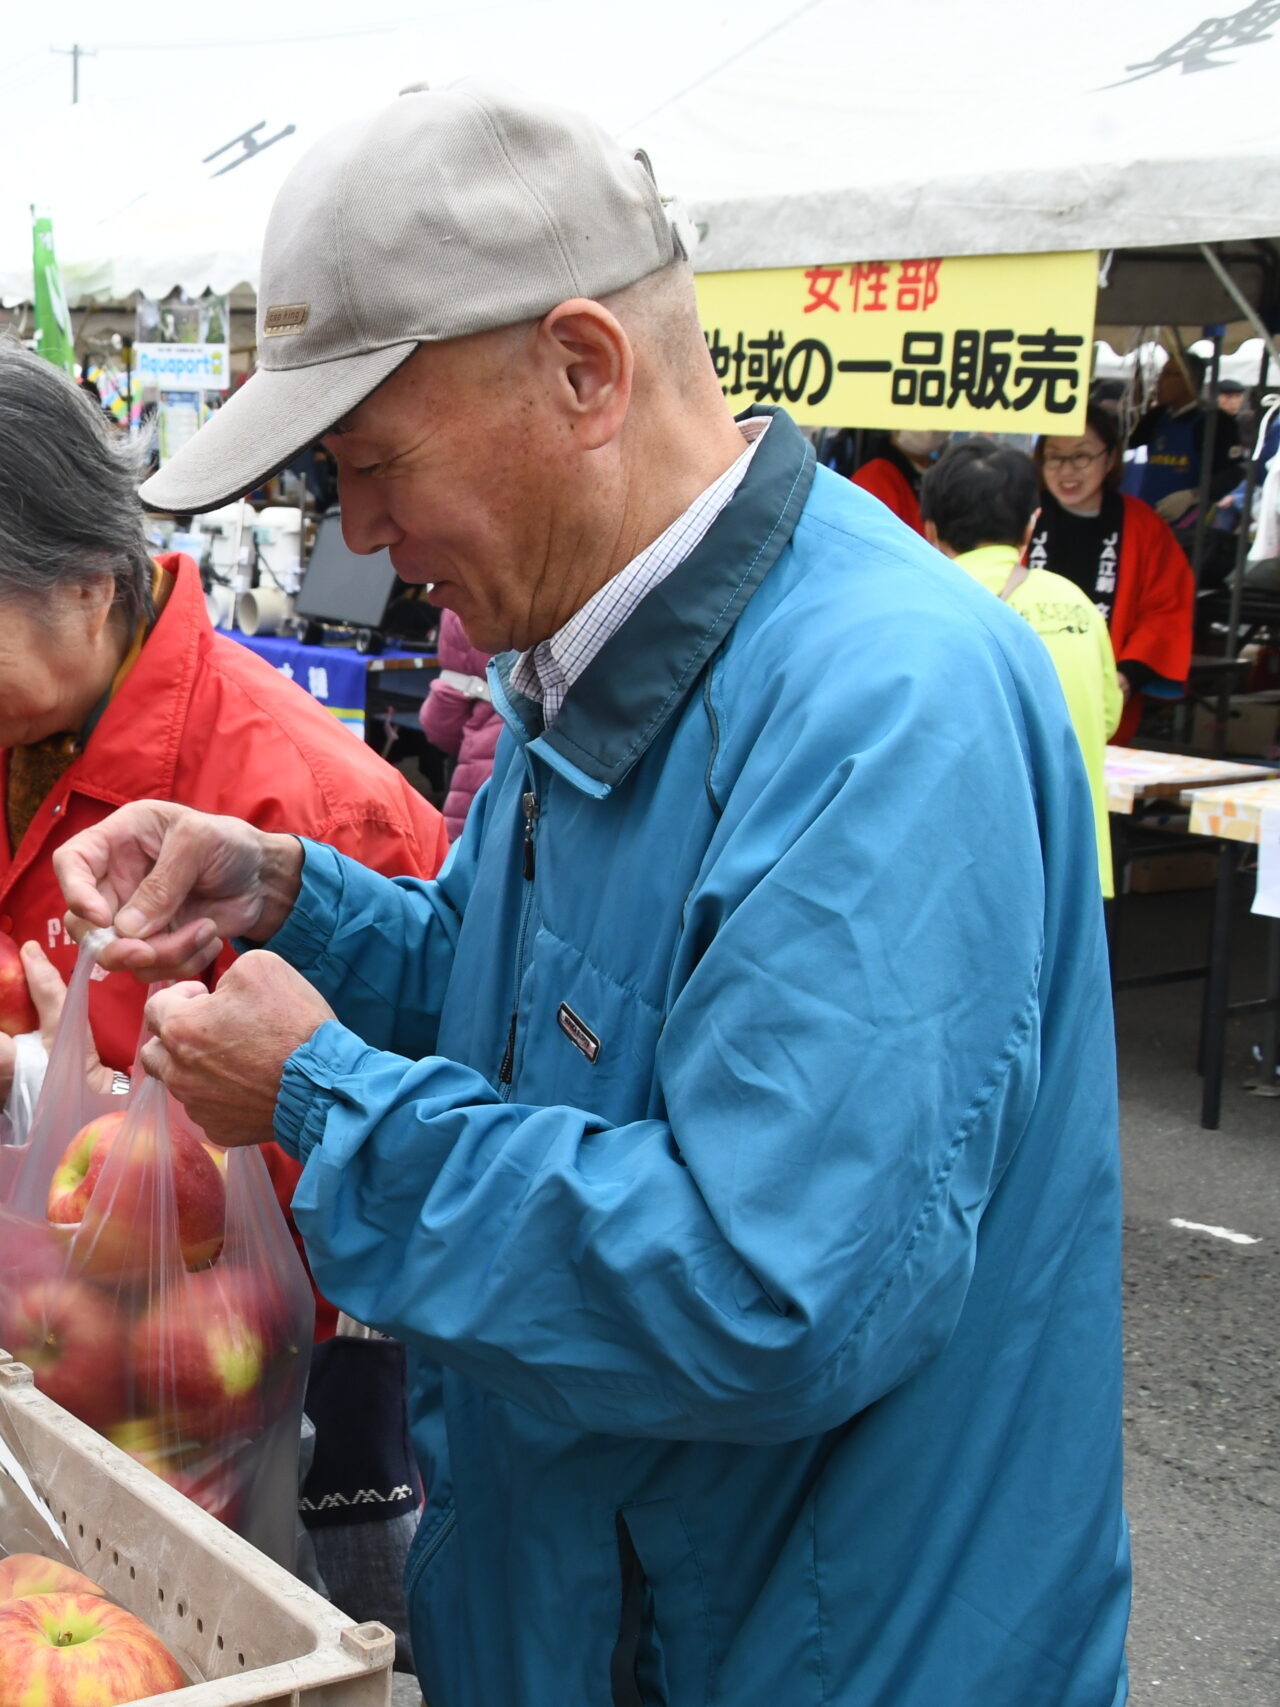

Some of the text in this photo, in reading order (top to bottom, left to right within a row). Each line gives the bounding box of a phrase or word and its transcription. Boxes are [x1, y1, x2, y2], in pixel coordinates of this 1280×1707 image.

[803, 258, 944, 314] 女性部
[140, 352, 210, 381] Aquaport
